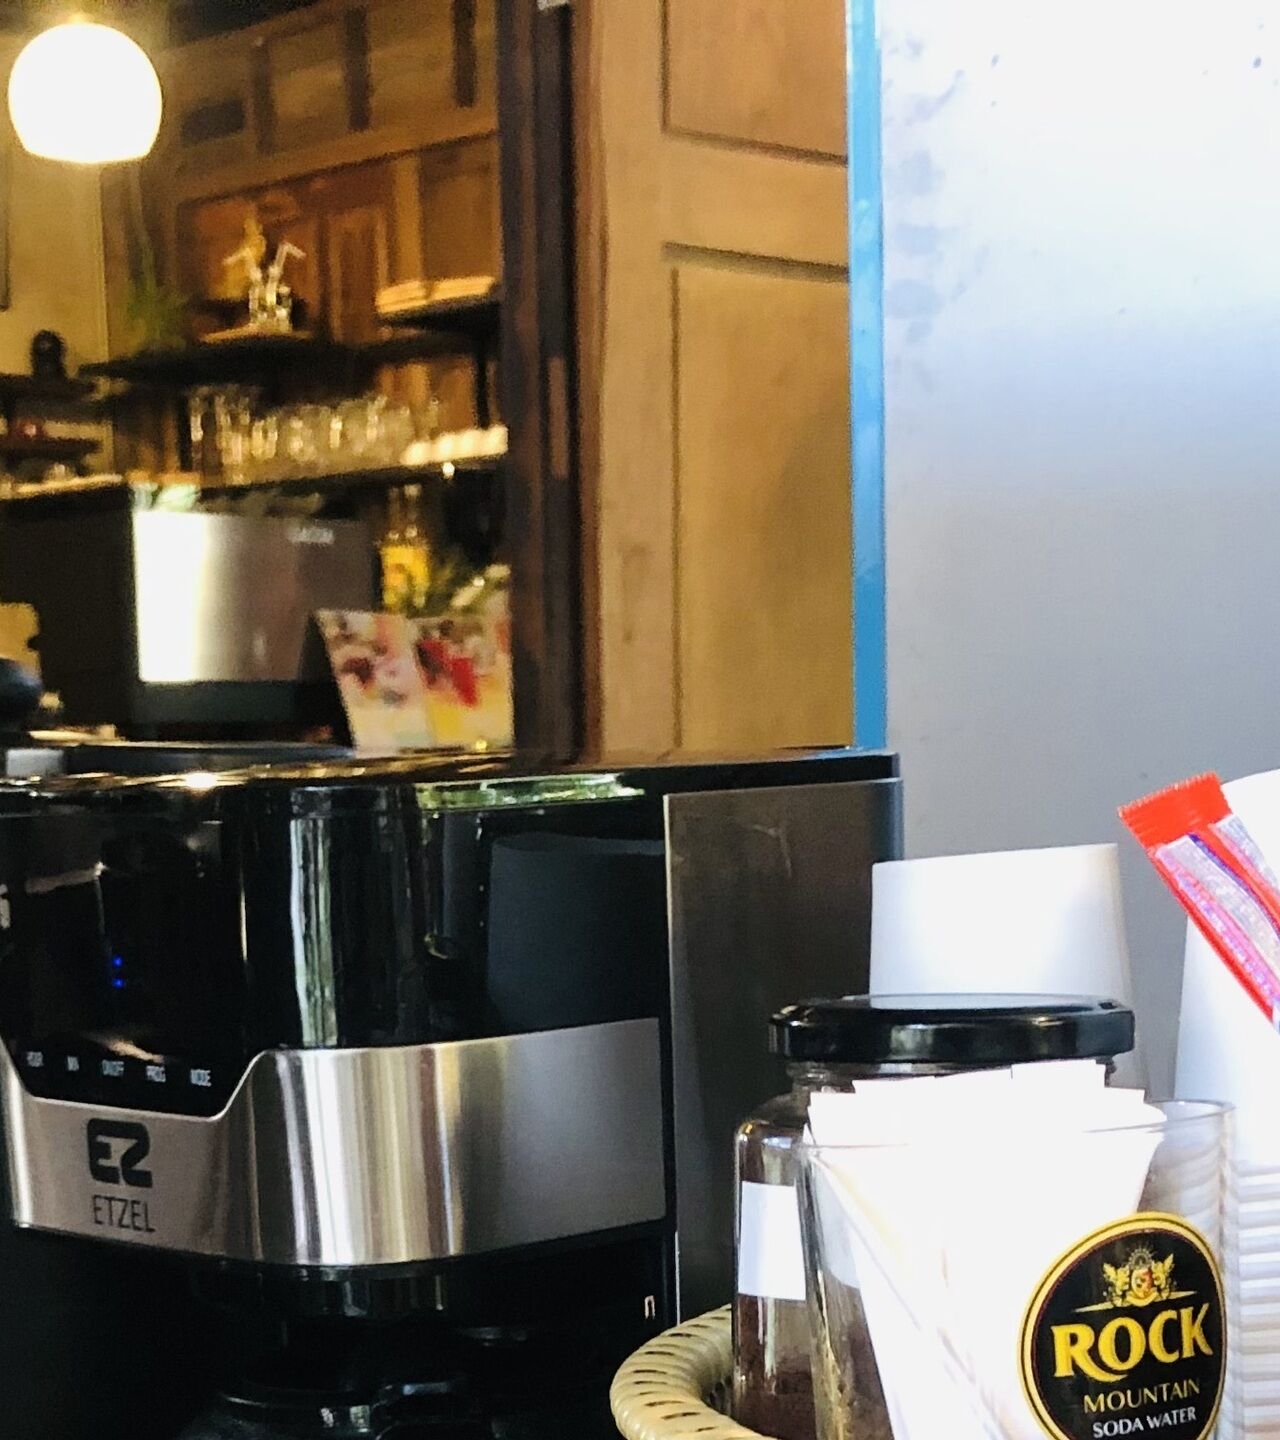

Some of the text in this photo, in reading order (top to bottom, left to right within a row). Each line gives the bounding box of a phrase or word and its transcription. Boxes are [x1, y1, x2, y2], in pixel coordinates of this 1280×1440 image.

[92, 1194, 156, 1234] ETZEL
[1051, 1303, 1213, 1382] ROCK
[1083, 1377, 1200, 1415] MOUNTAIN
[1092, 1406, 1197, 1439] SODA WATER
